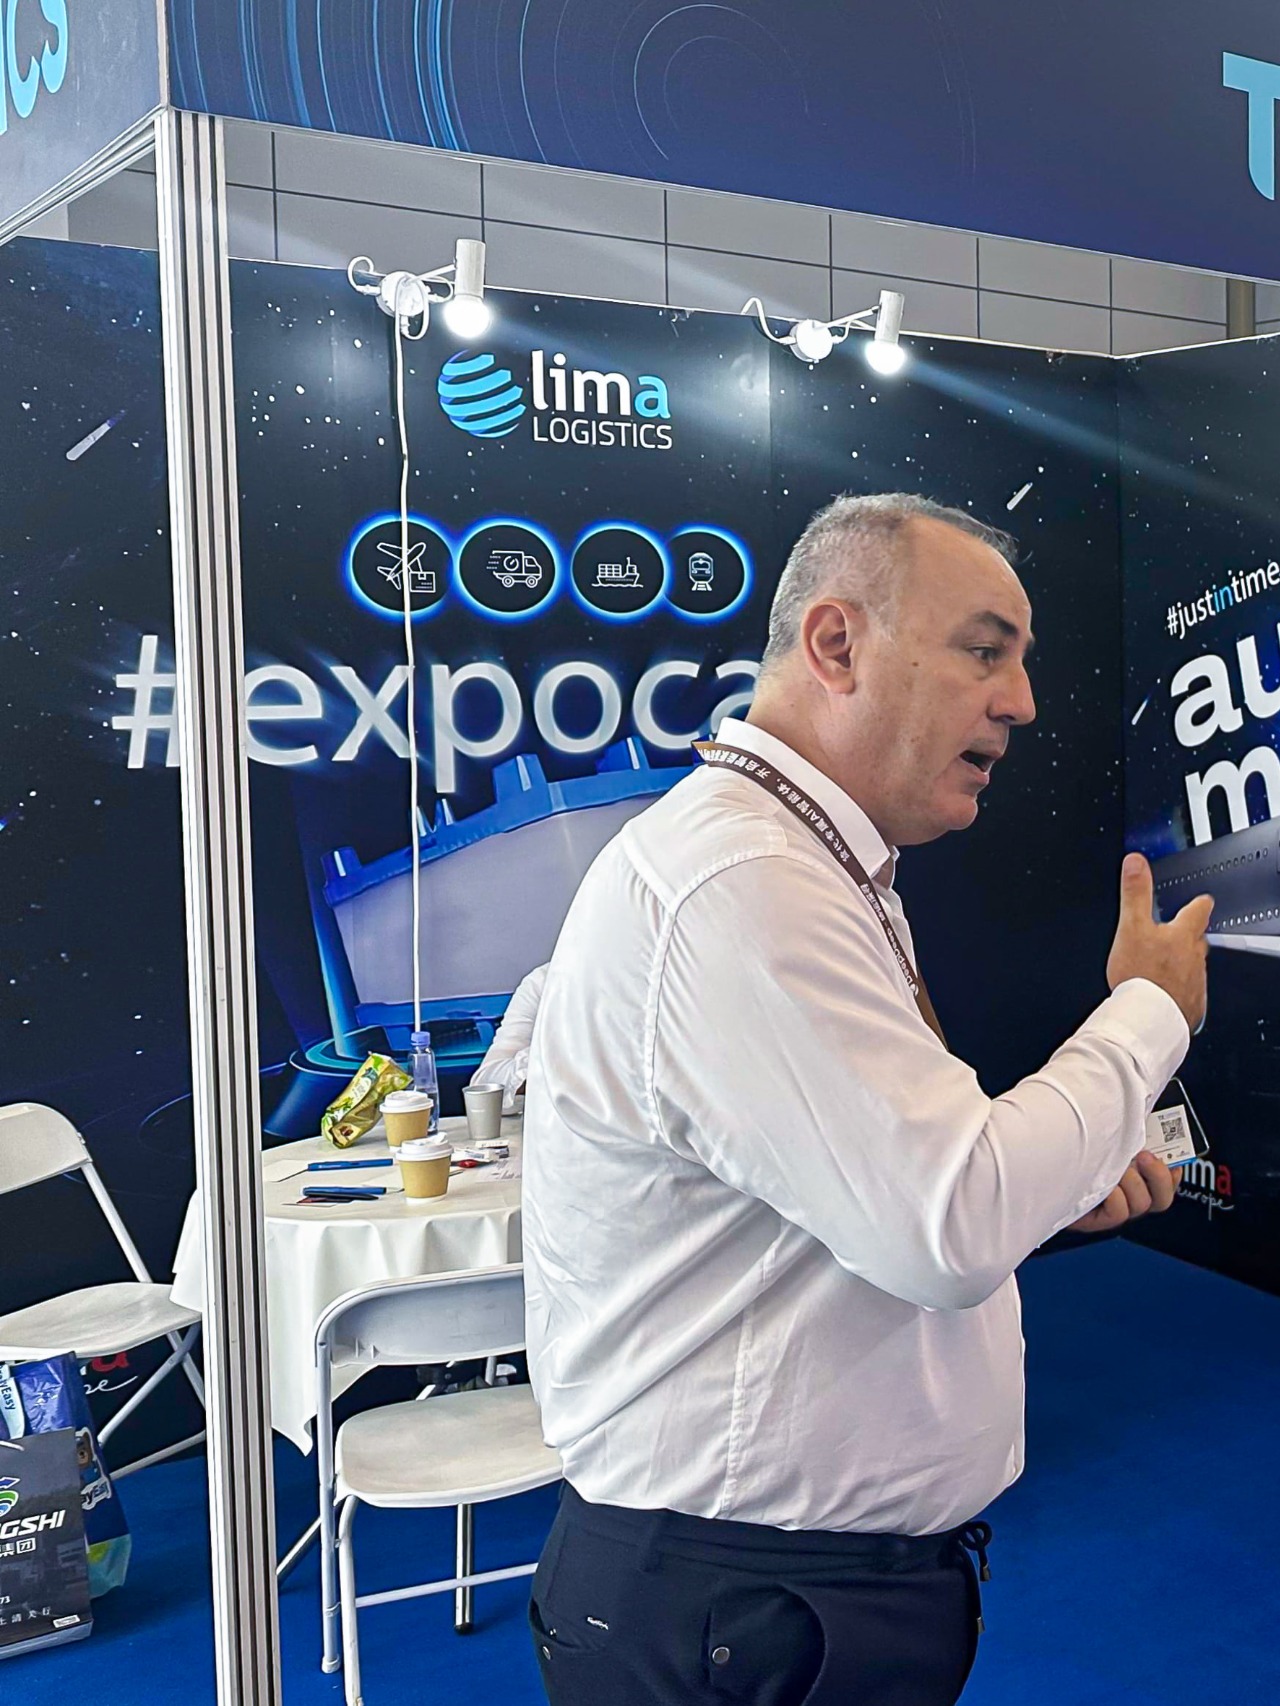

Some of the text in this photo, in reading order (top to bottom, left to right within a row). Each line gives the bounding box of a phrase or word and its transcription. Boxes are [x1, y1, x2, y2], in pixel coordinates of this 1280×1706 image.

[531, 350, 671, 419] lima
[533, 416, 673, 450] LOGISTICS
[1166, 561, 1280, 640] #justintime
[1183, 1158, 1232, 1197] ima
[0, 1509, 66, 1540] GSHI
